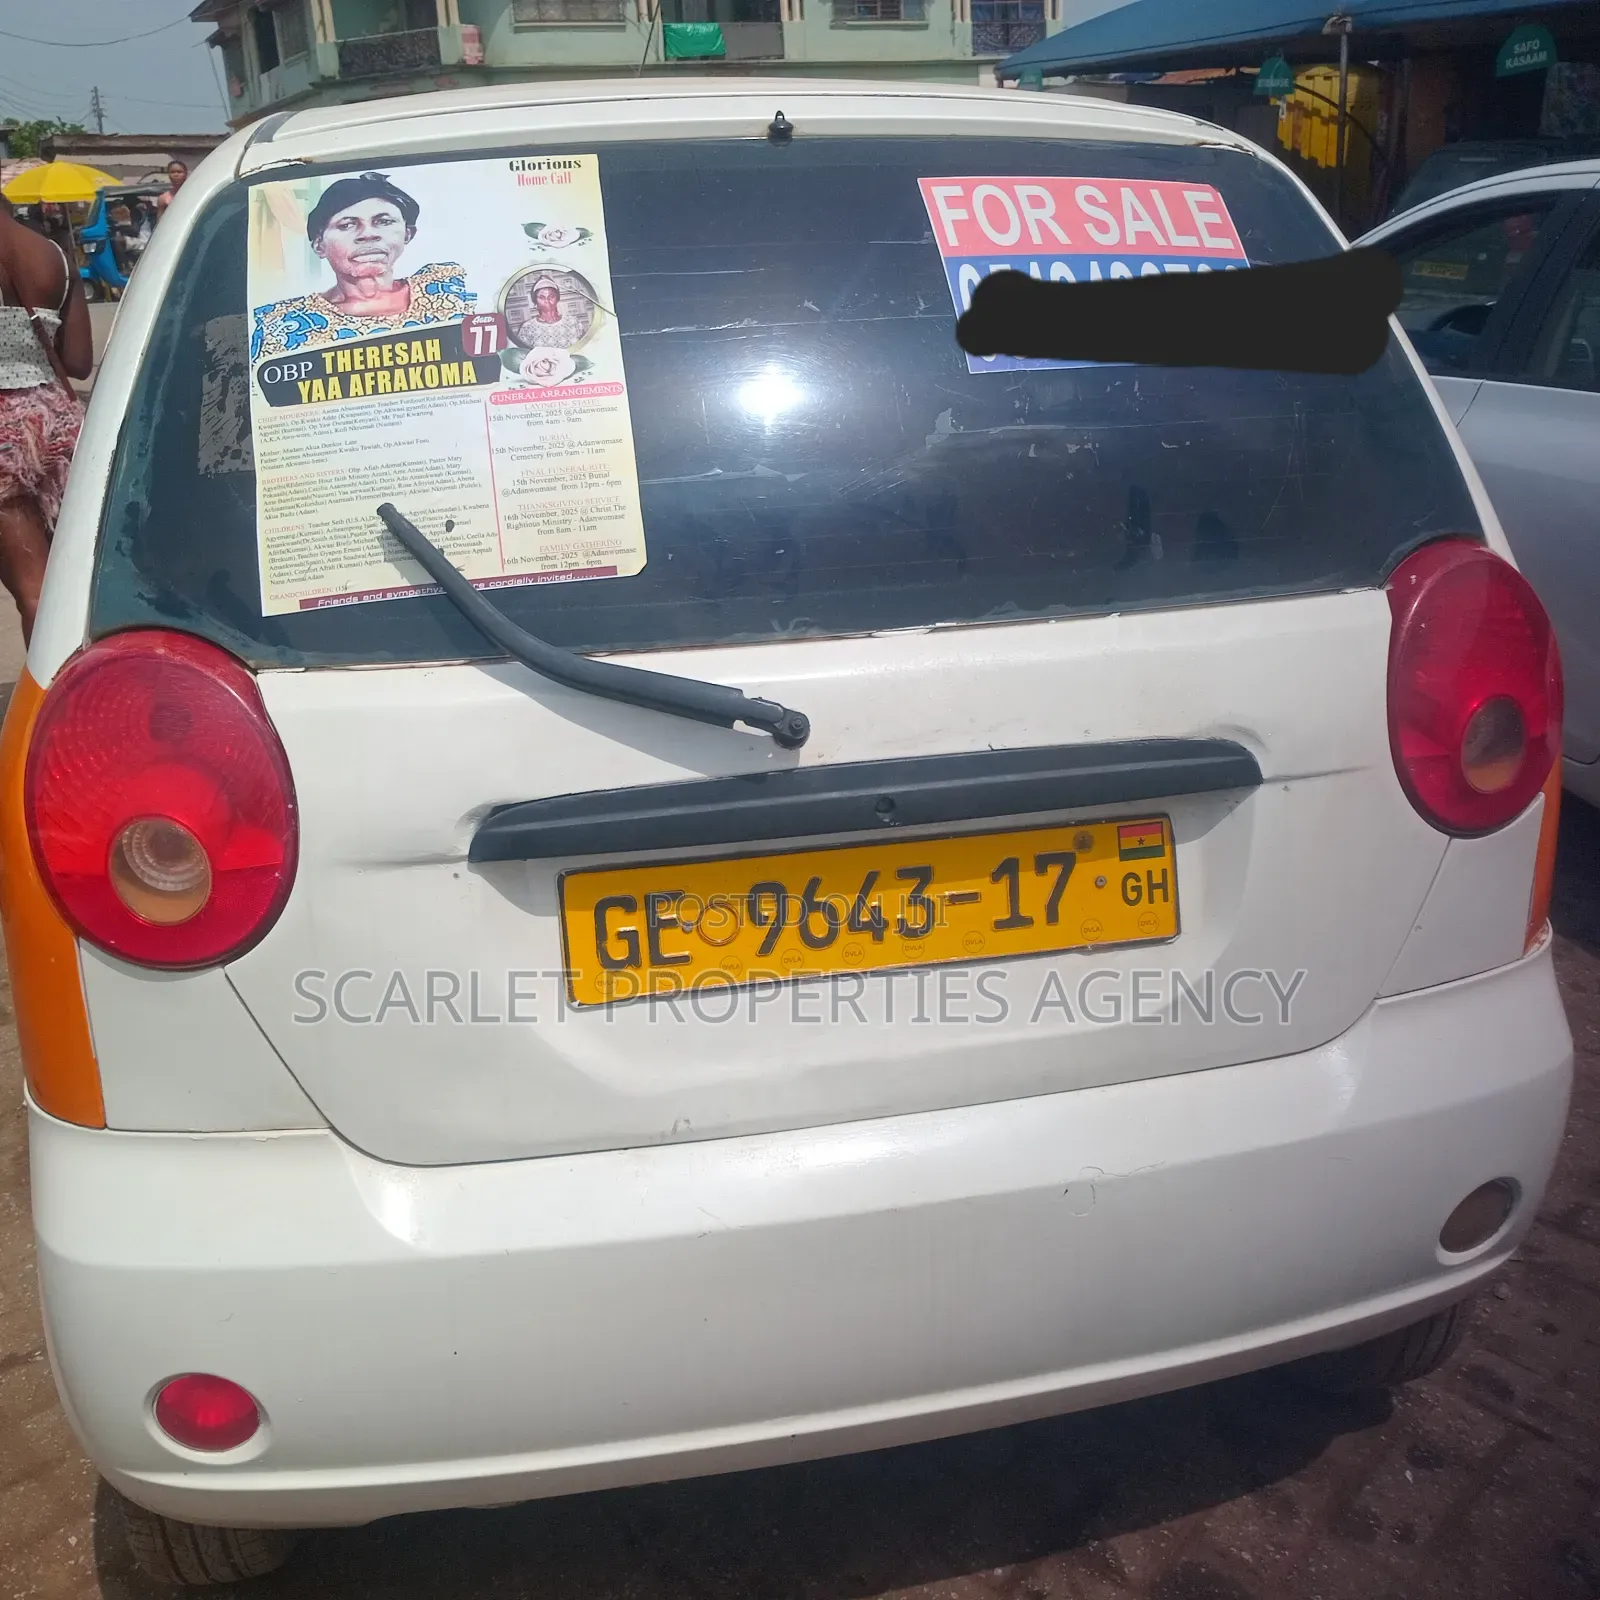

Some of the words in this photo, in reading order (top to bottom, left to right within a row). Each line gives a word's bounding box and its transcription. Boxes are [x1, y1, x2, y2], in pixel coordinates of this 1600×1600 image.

[1514, 39, 1540, 54] SAFO
[509, 158, 582, 172] Glorious
[517, 174, 547, 186] Home
[550, 172, 572, 184] Call
[931, 185, 1071, 247] FOR
[1074, 185, 1235, 250] SALE
[470, 325, 498, 354] 77
[264, 361, 313, 384] OBP
[322, 338, 442, 374] THERESAH
[297, 376, 343, 404] YAA
[350, 361, 478, 398] AFRAKOMA
[491, 392, 539, 403] FUNERAL
[540, 385, 622, 398] ARRANGEMENTS
[525, 402, 556, 410] LAYING
[506, 412, 543, 421] November,
[564, 407, 618, 417] @Adanwomase
[508, 445, 546, 454] November,
[566, 442, 575, 450] @
[577, 439, 622, 448] Adanwomase
[548, 465, 586, 474] FUNERAL
[262, 475, 298, 485] BROTHERS
[530, 476, 568, 485] November,
[588, 472, 610, 480] Burial
[502, 486, 557, 497] @Adanwomase
[518, 499, 583, 511] THANKSGIVING
[585, 496, 621, 505] SERVICE
[579, 515, 625, 523] Adanwomase
[580, 508, 589, 516] @
[540, 544, 569, 552] FAMILY
[572, 539, 622, 549] GATHERING
[582, 549, 637, 559] @Adanwomase
[270, 588, 334, 601] GRANDCHILDREN:
[318, 596, 358, 607] Friends
[363, 592, 382, 602] and
[489, 574, 534, 587] cordially
[1122, 868, 1169, 906] GH
[594, 890, 693, 970] GE
[748, 850, 1076, 956] 9643-17
